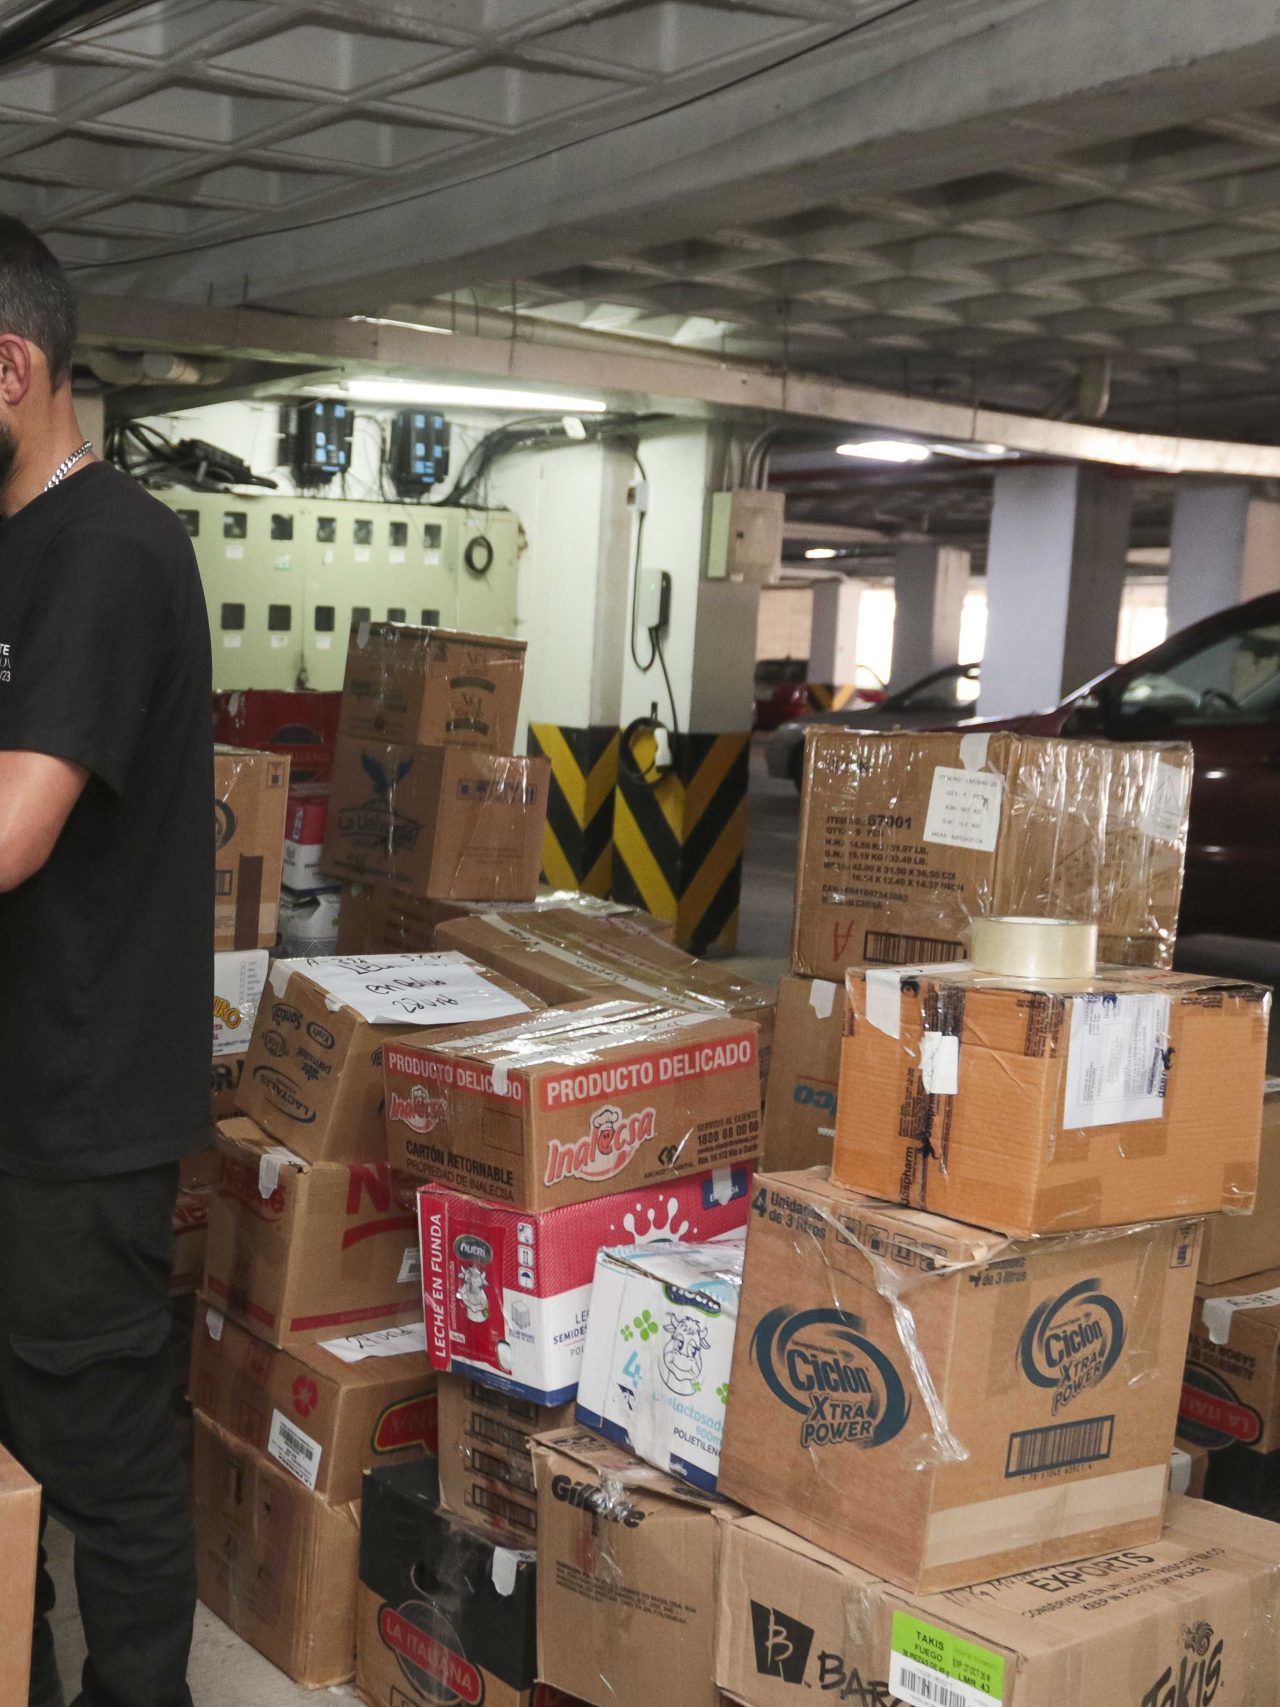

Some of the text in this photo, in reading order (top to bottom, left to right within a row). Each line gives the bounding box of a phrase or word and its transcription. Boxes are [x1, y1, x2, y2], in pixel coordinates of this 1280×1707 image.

[389, 1053, 521, 1099] PRODUCTO DELICDO
[547, 1040, 751, 1105] PRODUCTO DELICADO
[545, 1107, 656, 1187] Inalecsa
[448, 1153, 513, 1186] RETORNABLE
[752, 1188, 768, 1218] 4
[769, 1207, 782, 1223] de
[786, 1214, 793, 1228] 3
[429, 1214, 447, 1358] LECHE EN FUNDA
[1053, 1364, 1104, 1414] POWER
[695, 1426, 721, 1445] 900m
[804, 1420, 873, 1446] POWER
[1026, 1551, 1155, 1593] EXPORTS
[386, 1618, 402, 1643] LA
[916, 1630, 945, 1652] TAKIS
[914, 1643, 943, 1663] FUEGO
